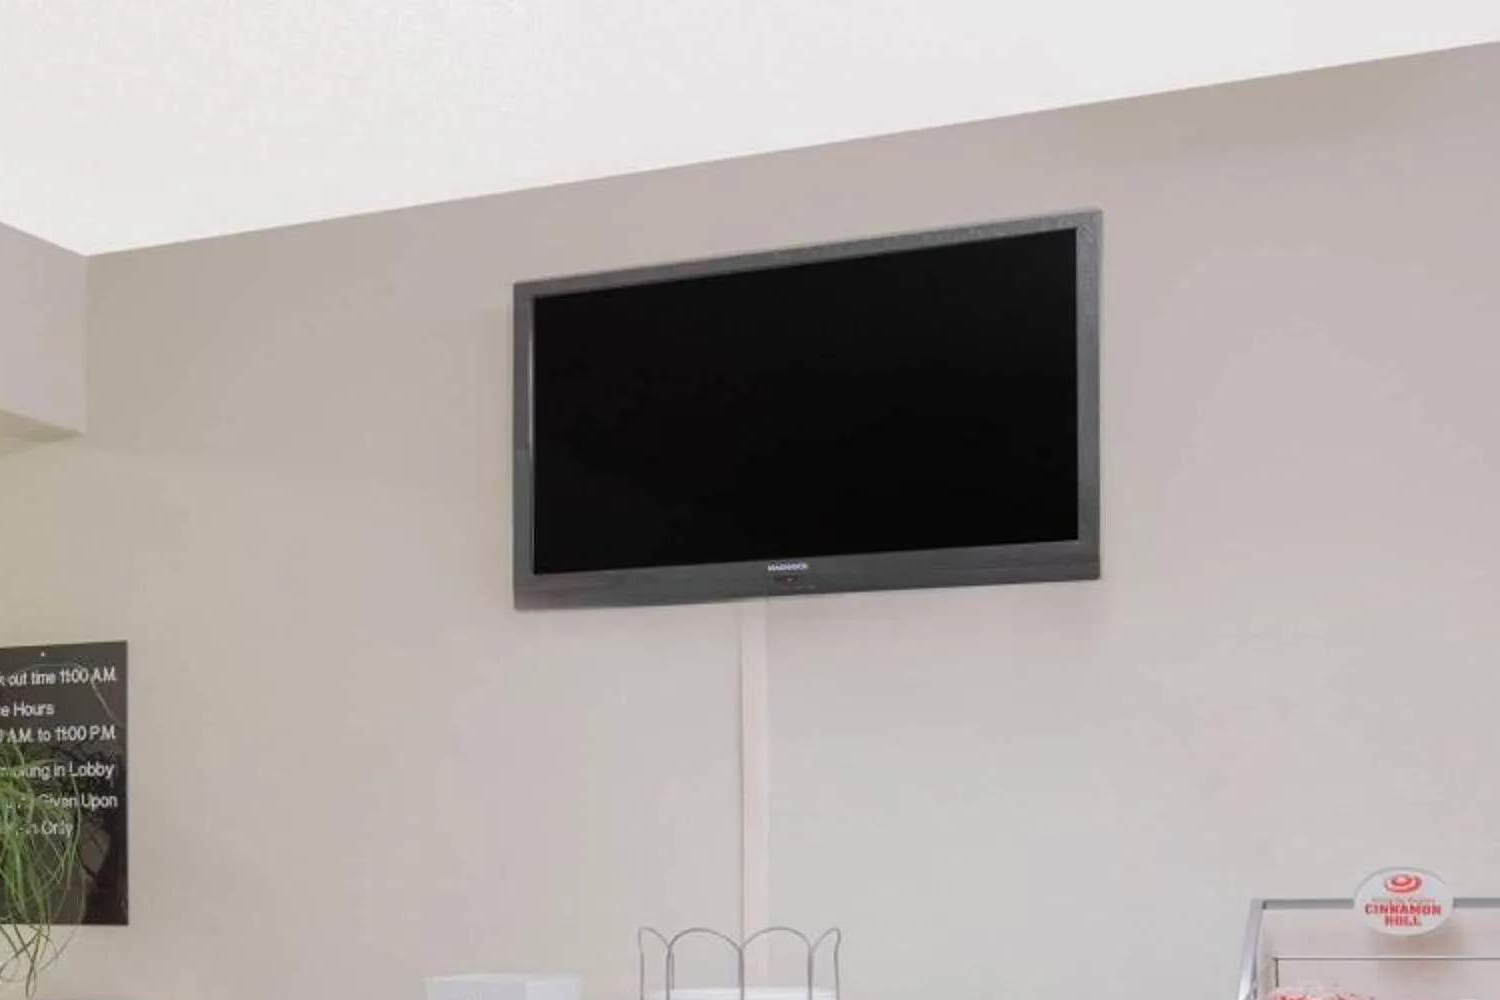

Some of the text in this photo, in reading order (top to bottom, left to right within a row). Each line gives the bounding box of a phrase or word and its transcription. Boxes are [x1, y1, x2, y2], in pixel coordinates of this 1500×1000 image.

[7, 674, 28, 686] out
[31, 670, 56, 685] time
[13, 701, 55, 717] Hours
[37, 726, 51, 741] to
[53, 763, 65, 776] in
[69, 761, 115, 779] Lobby
[80, 793, 118, 811] Upon
[1365, 903, 1443, 915] CINNAMON
